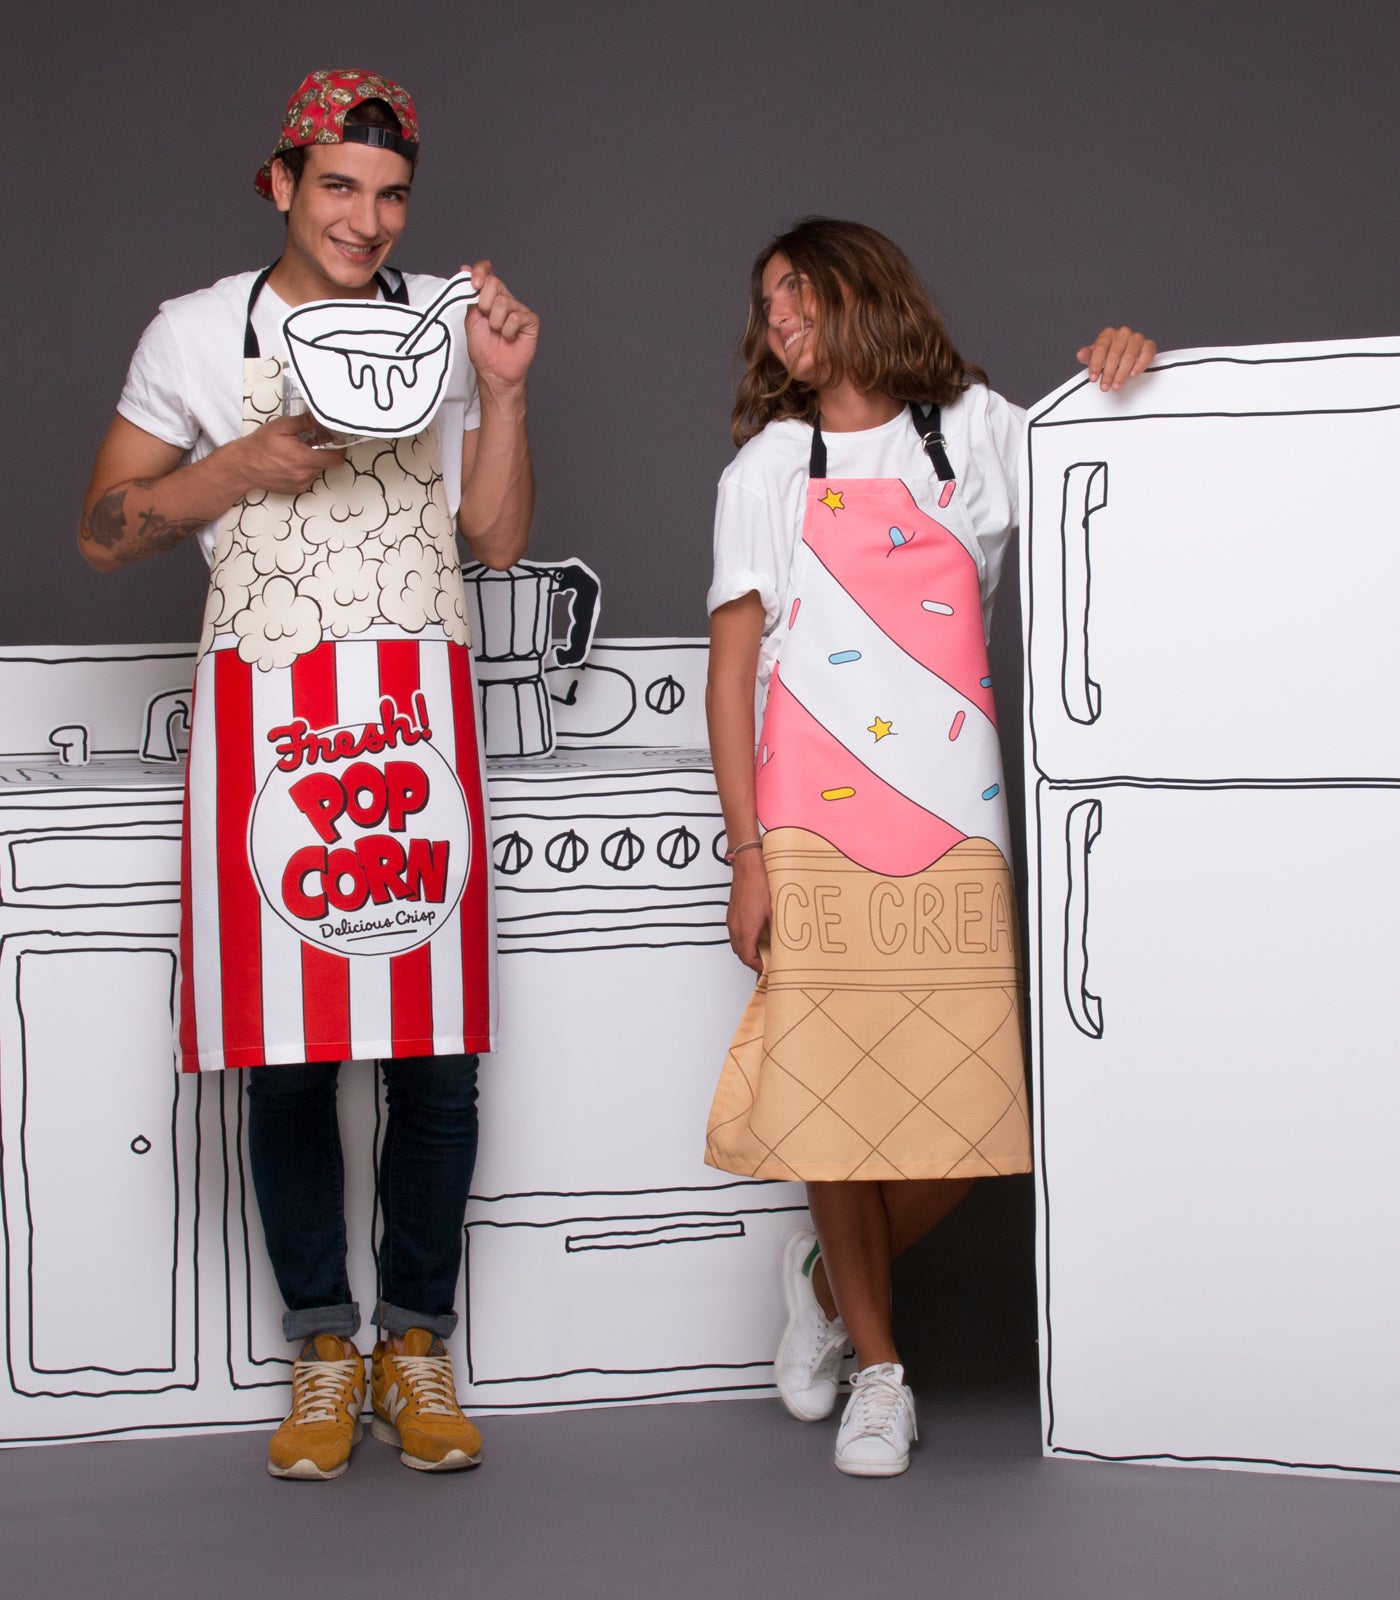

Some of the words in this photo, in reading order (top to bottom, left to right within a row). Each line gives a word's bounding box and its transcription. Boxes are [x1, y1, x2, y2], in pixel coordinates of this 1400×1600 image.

[267, 692, 433, 773] Fresh!
[288, 760, 430, 845] POP
[281, 834, 450, 921] CORN
[775, 882, 847, 954] CE
[868, 881, 1015, 955] CREA
[319, 919, 394, 938] Delicious
[395, 910, 436, 925] Crisp
